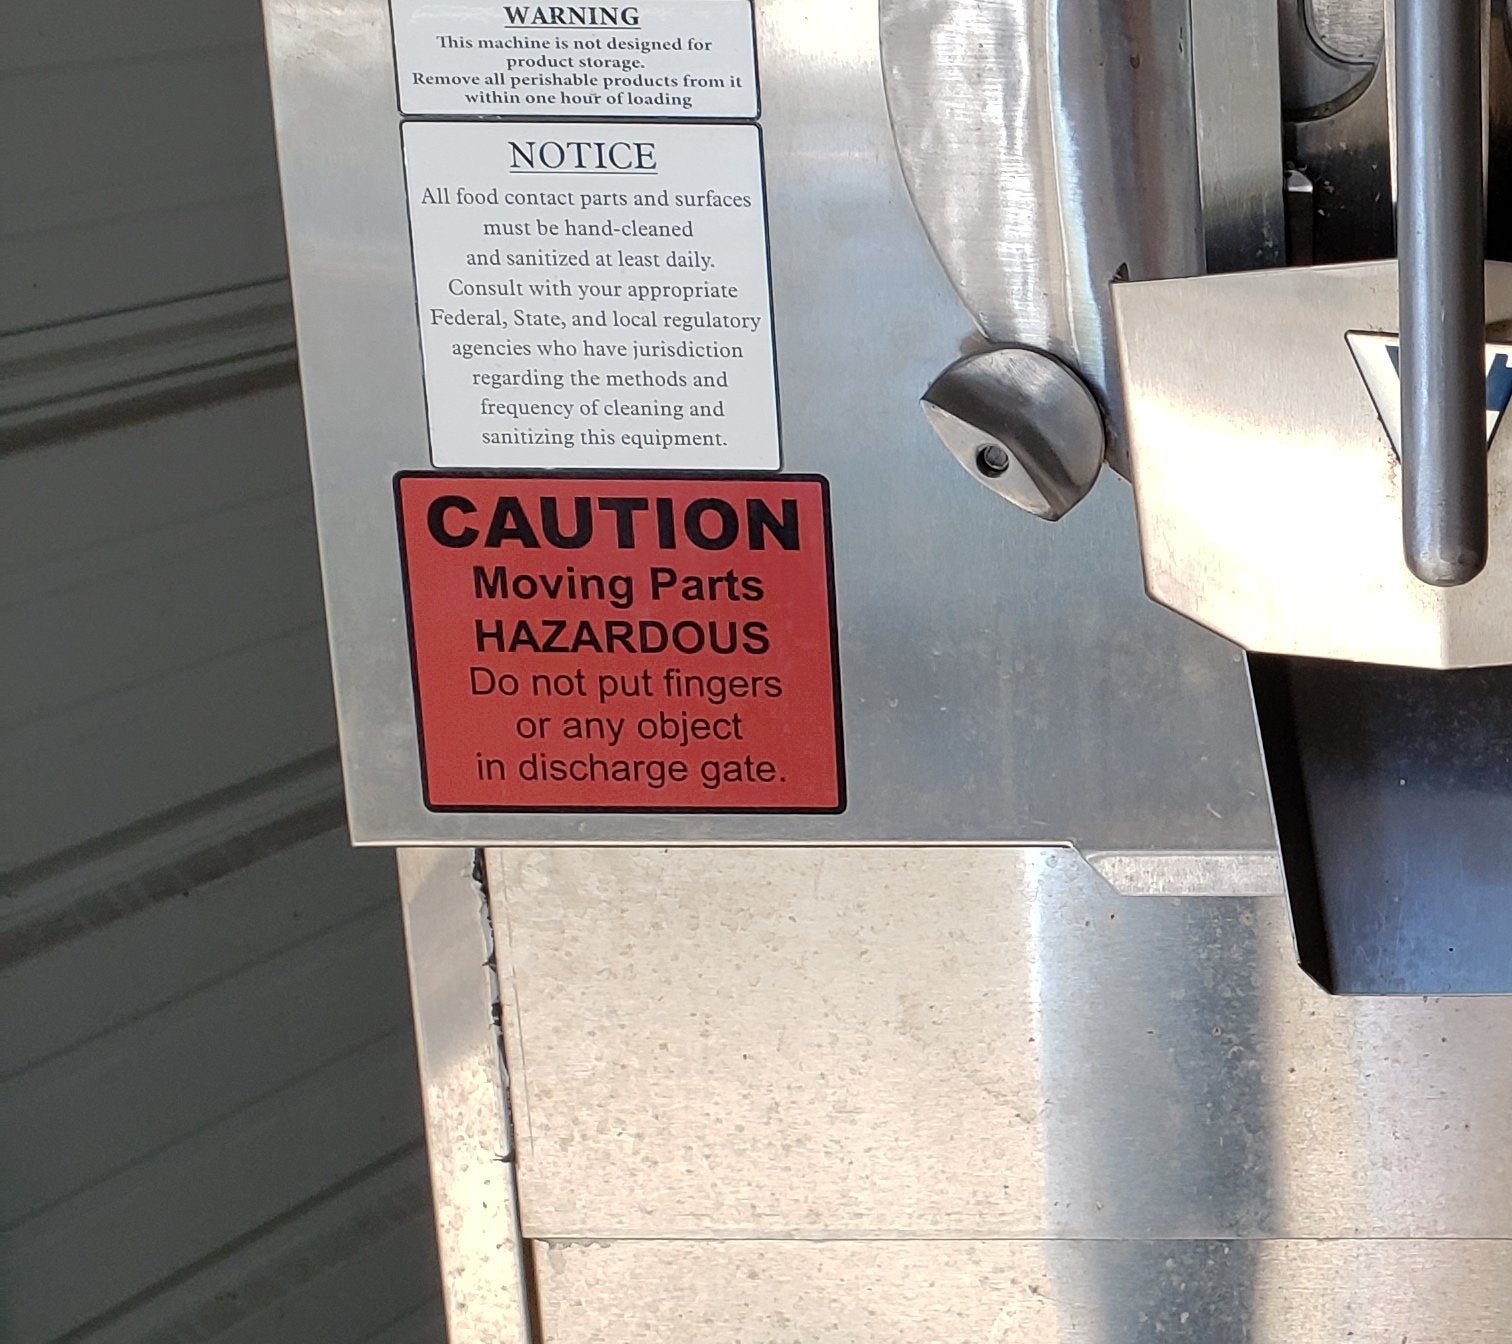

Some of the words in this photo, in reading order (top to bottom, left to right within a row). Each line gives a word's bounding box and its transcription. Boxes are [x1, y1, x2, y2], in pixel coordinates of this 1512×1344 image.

[503, 7, 639, 25] WARNING
[436, 36, 473, 48] This
[479, 36, 550, 49] machine
[555, 37, 568, 49] is
[574, 39, 602, 49] not
[607, 37, 682, 54] designed
[688, 38, 712, 50] for
[506, 55, 574, 70] product
[579, 57, 644, 72] storage.
[412, 73, 480, 85] Remove
[485, 73, 504, 85] all
[511, 73, 598, 89] perishable
[603, 74, 678, 89] products
[683, 74, 724, 87] from
[731, 76, 742, 87] it
[465, 91, 520, 103] within
[526, 95, 556, 103] one
[561, 91, 601, 104] hour
[607, 92, 624, 104] of
[628, 92, 692, 109] loading
[508, 142, 656, 169] NOTICE
[422, 188, 450, 204] All
[457, 188, 499, 204] food
[505, 193, 575, 205] contact
[580, 193, 627, 209] parts
[634, 190, 669, 206] and
[675, 190, 751, 207] surfaces
[484, 223, 531, 235] must
[536, 219, 558, 235] be
[565, 219, 693, 237] hand-cleaned
[467, 249, 501, 265] and
[507, 249, 590, 266] sanitized
[596, 254, 613, 266] at
[618, 250, 660, 267] least
[666, 251, 714, 271] daily.
[449, 279, 523, 295] Consult
[529, 280, 572, 296] with
[578, 285, 622, 300] your
[628, 284, 737, 301] appropriate
[430, 309, 507, 328] Federal,
[514, 310, 566, 329] State,
[572, 310, 607, 326] and
[613, 311, 657, 327] local
[664, 311, 761, 332] regulatory
[453, 339, 531, 359] agencies
[537, 340, 576, 356] who
[583, 340, 627, 356] have
[633, 341, 743, 360] jurisdiction
[473, 369, 564, 389] regarding
[570, 370, 600, 385] the
[606, 370, 687, 387] methods
[694, 371, 728, 387] and
[481, 398, 574, 419] frequency
[580, 399, 600, 415] of
[604, 400, 683, 420] cleaning
[690, 401, 725, 416] and
[482, 429, 574, 448] sanitizing
[581, 429, 615, 445] this
[622, 434, 727, 449] equipment.
[427, 495, 800, 550] CAUTION
[473, 566, 633, 609] Moving
[651, 567, 764, 601] Parts
[475, 620, 770, 654] HAZARDOUS
[470, 667, 518, 695] Do
[533, 669, 587, 696] not
[599, 669, 653, 704] put
[663, 668, 782, 704] fingers
[517, 718, 551, 738] or
[564, 718, 624, 746] any
[638, 711, 743, 746] object
[477, 752, 505, 780] in
[519, 753, 688, 788] discharge
[701, 756, 786, 789] gate.
